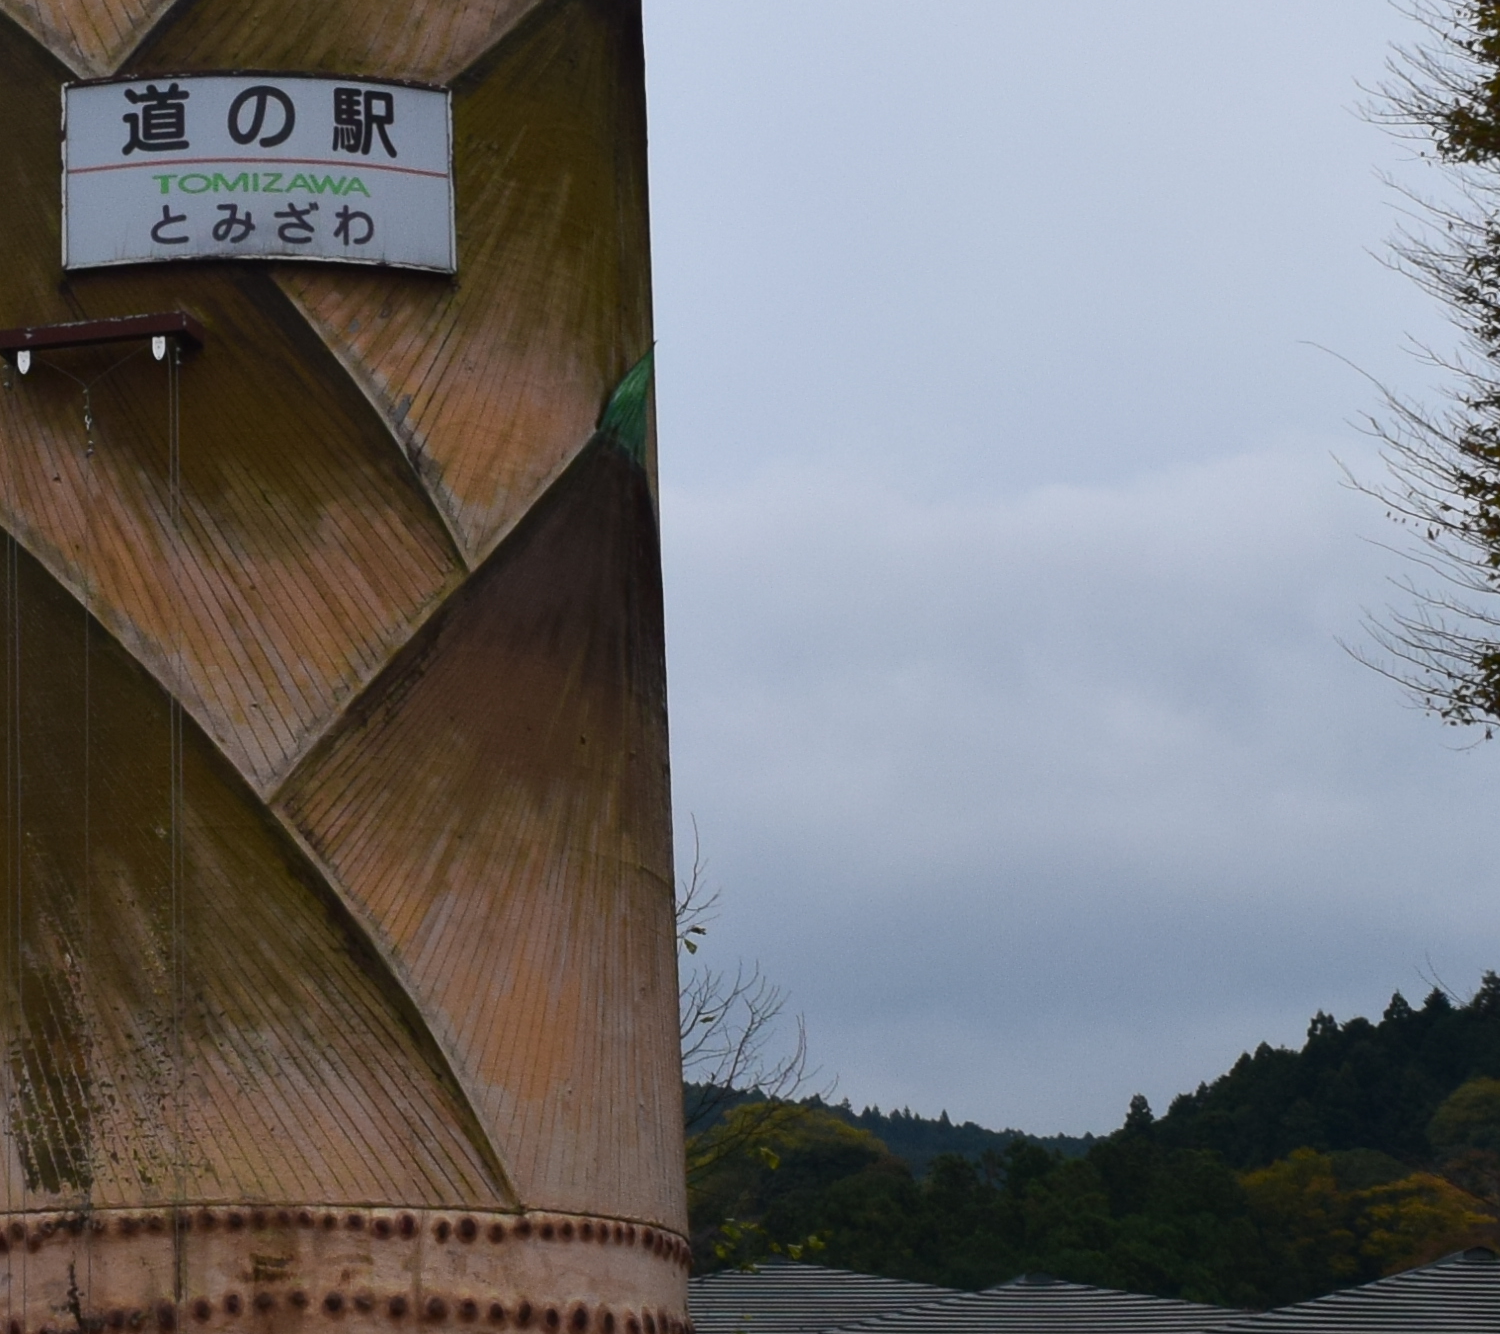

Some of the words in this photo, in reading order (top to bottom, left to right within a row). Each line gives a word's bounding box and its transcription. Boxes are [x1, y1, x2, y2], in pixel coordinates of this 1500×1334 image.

[121, 82, 397, 158] 道の駅
[152, 172, 371, 197] TOMIZAWA
[150, 202, 374, 246] とみざわ
